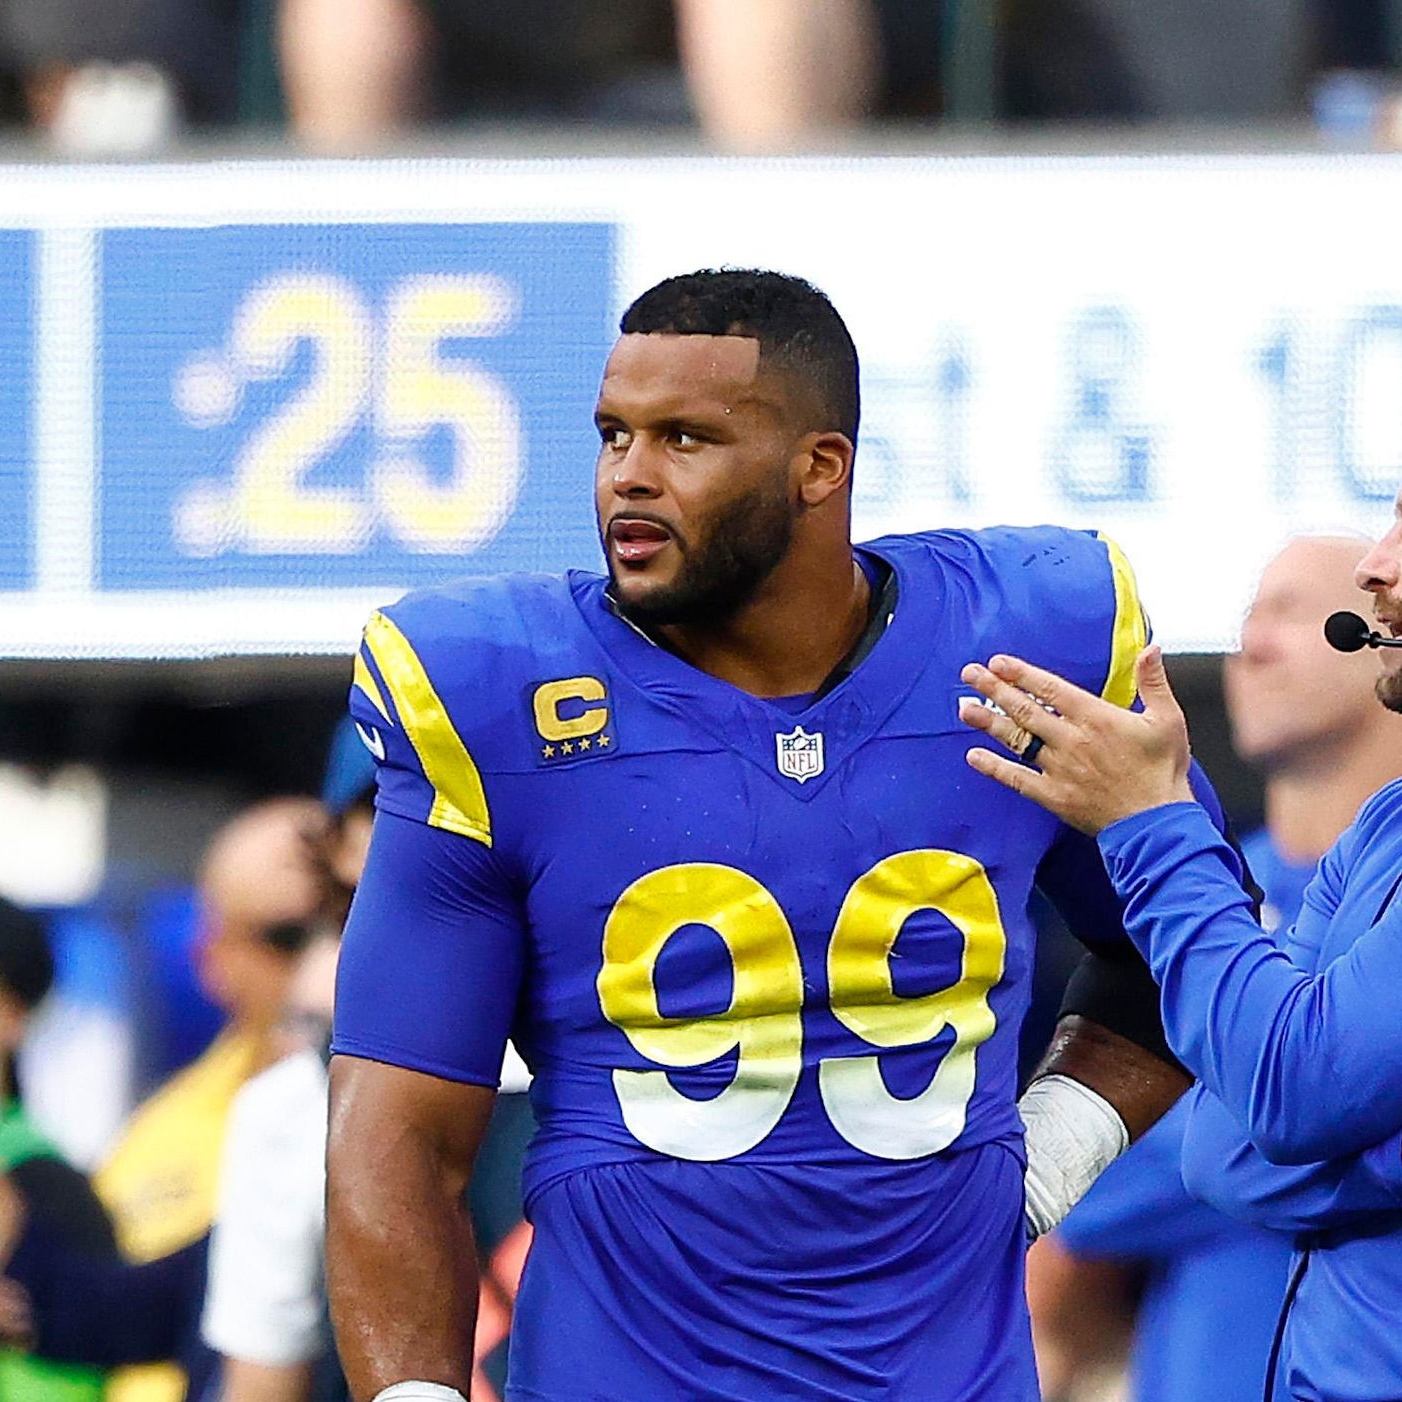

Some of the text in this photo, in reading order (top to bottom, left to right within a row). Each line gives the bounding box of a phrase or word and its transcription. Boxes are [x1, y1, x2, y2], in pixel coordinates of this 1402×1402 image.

[533, 676, 608, 741] C
[786, 753, 816, 771] NFL
[597, 849, 1006, 1162] 99
